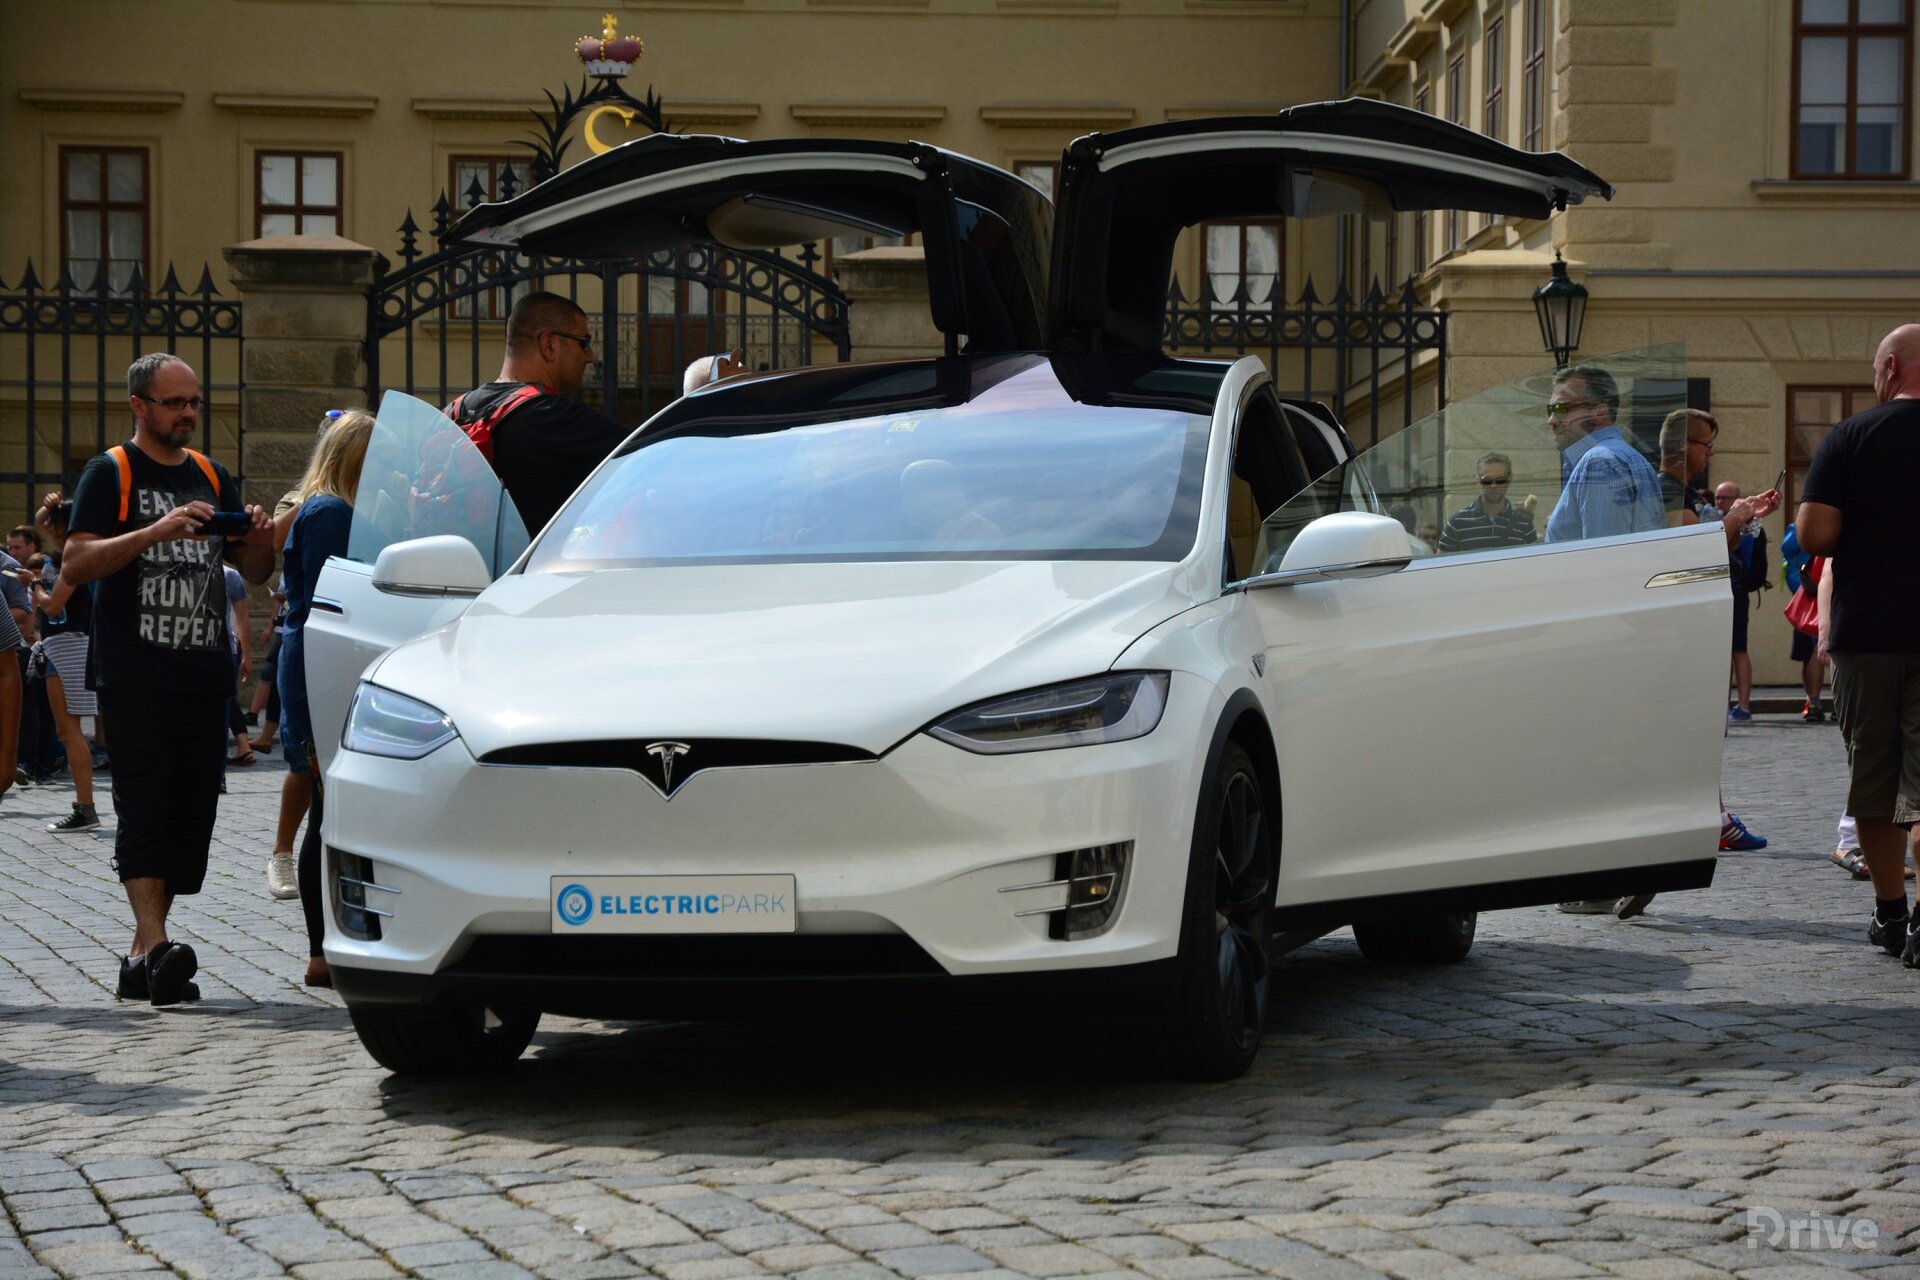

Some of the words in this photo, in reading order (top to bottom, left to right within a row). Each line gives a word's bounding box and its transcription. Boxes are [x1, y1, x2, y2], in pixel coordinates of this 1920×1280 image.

[138, 489, 176, 515] EAT
[141, 577, 195, 609] RUN
[600, 894, 786, 914] ELECTRICPARK
